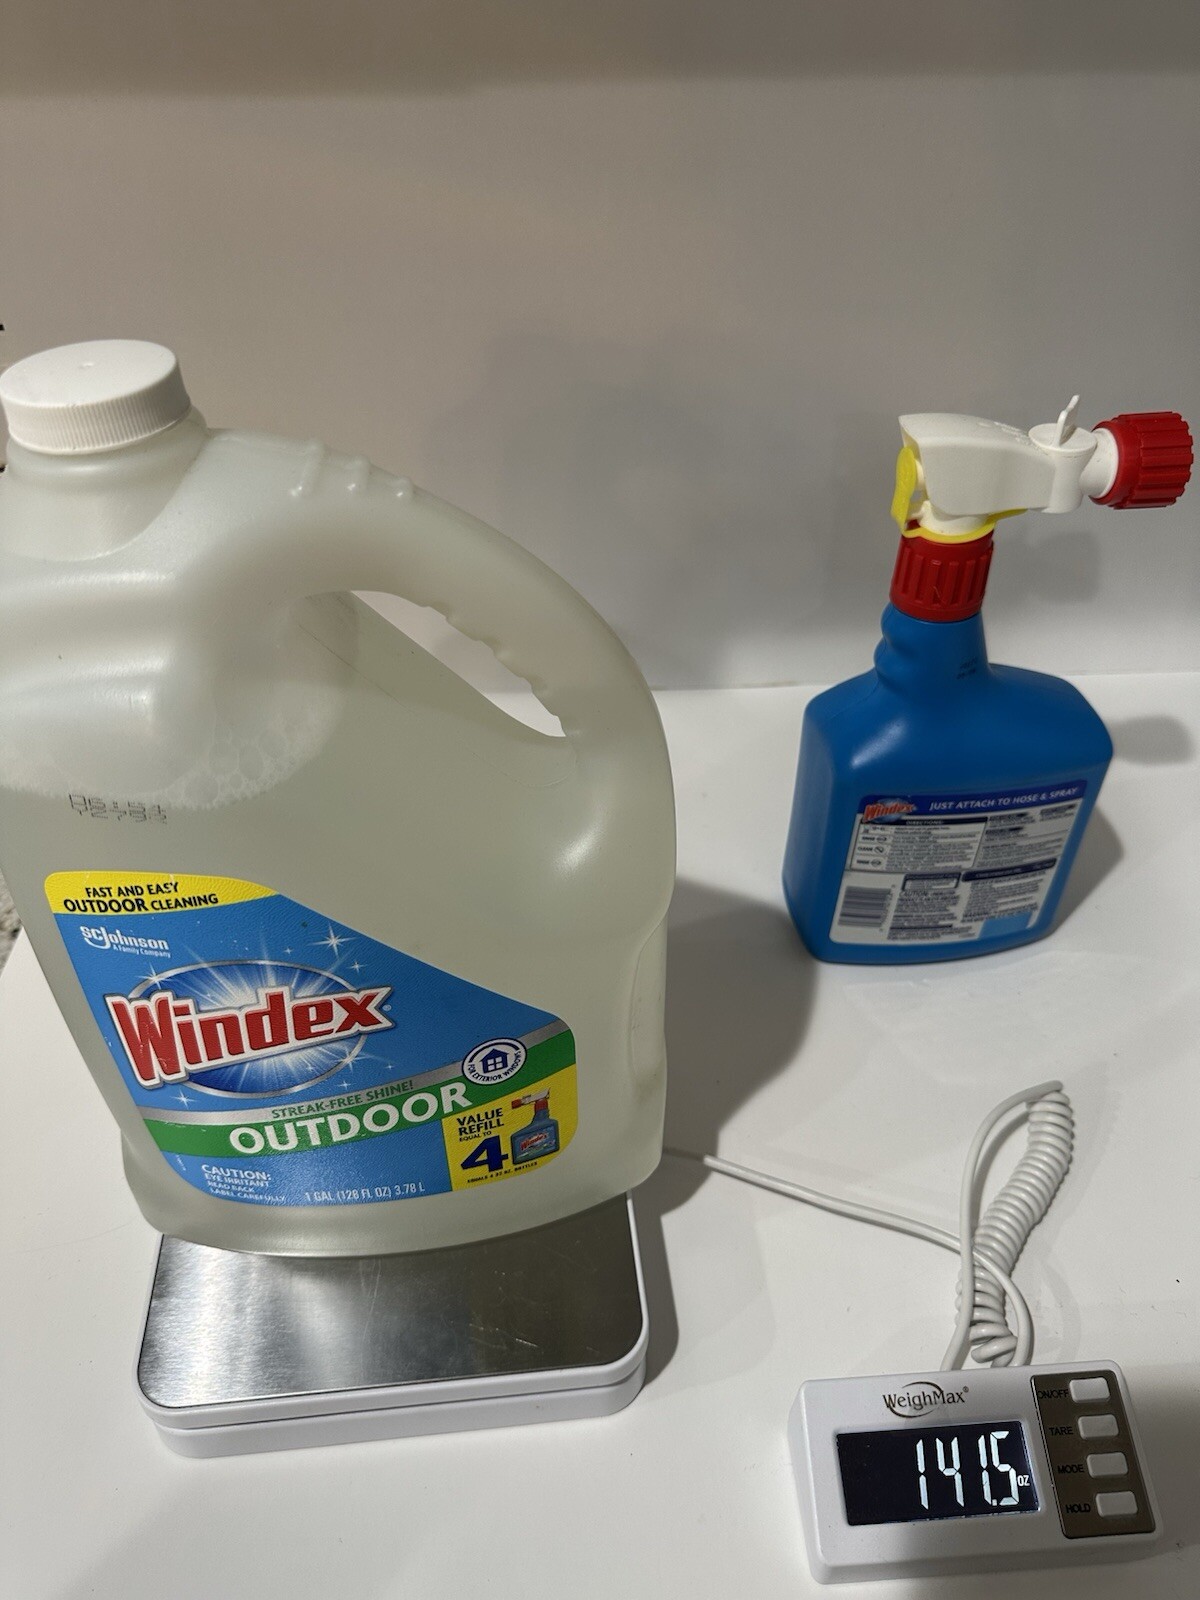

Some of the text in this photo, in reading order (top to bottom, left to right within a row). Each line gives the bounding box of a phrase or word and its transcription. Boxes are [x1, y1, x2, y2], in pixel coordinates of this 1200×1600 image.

[929, 801, 953, 811] JUST
[955, 798, 994, 810] ATTACH
[998, 797, 1009, 806] TO
[1013, 794, 1039, 804] HOSE
[1049, 787, 1078, 799] SPRAY
[863, 802, 914, 823] Windex
[85, 882, 179, 898] FAST AND EASY
[63, 893, 219, 913] OUTDOOR CLEANING
[105, 987, 394, 1087] Windex
[272, 1080, 414, 1119] STREAK-FREE SHINE!
[229, 1081, 473, 1154] OUTDOOR
[456, 1108, 503, 1126] VALUE
[458, 1118, 504, 1136] REFILL
[459, 1130, 492, 1142] EQUAL TO
[460, 1135, 508, 1173] 4
[201, 1164, 271, 1180] CAUTION:
[204, 1173, 269, 1187] EYE IRRITANT
[305, 1181, 425, 1202] 1 GAL (128 FL OZ) 3.78 L
[1037, 1388, 1069, 1399] ON/OFF
[1049, 1426, 1074, 1436] TARE
[915, 1430, 1019, 1510] 141.5
[1057, 1464, 1085, 1474] MODE
[1066, 1503, 1091, 1513] HOLD
